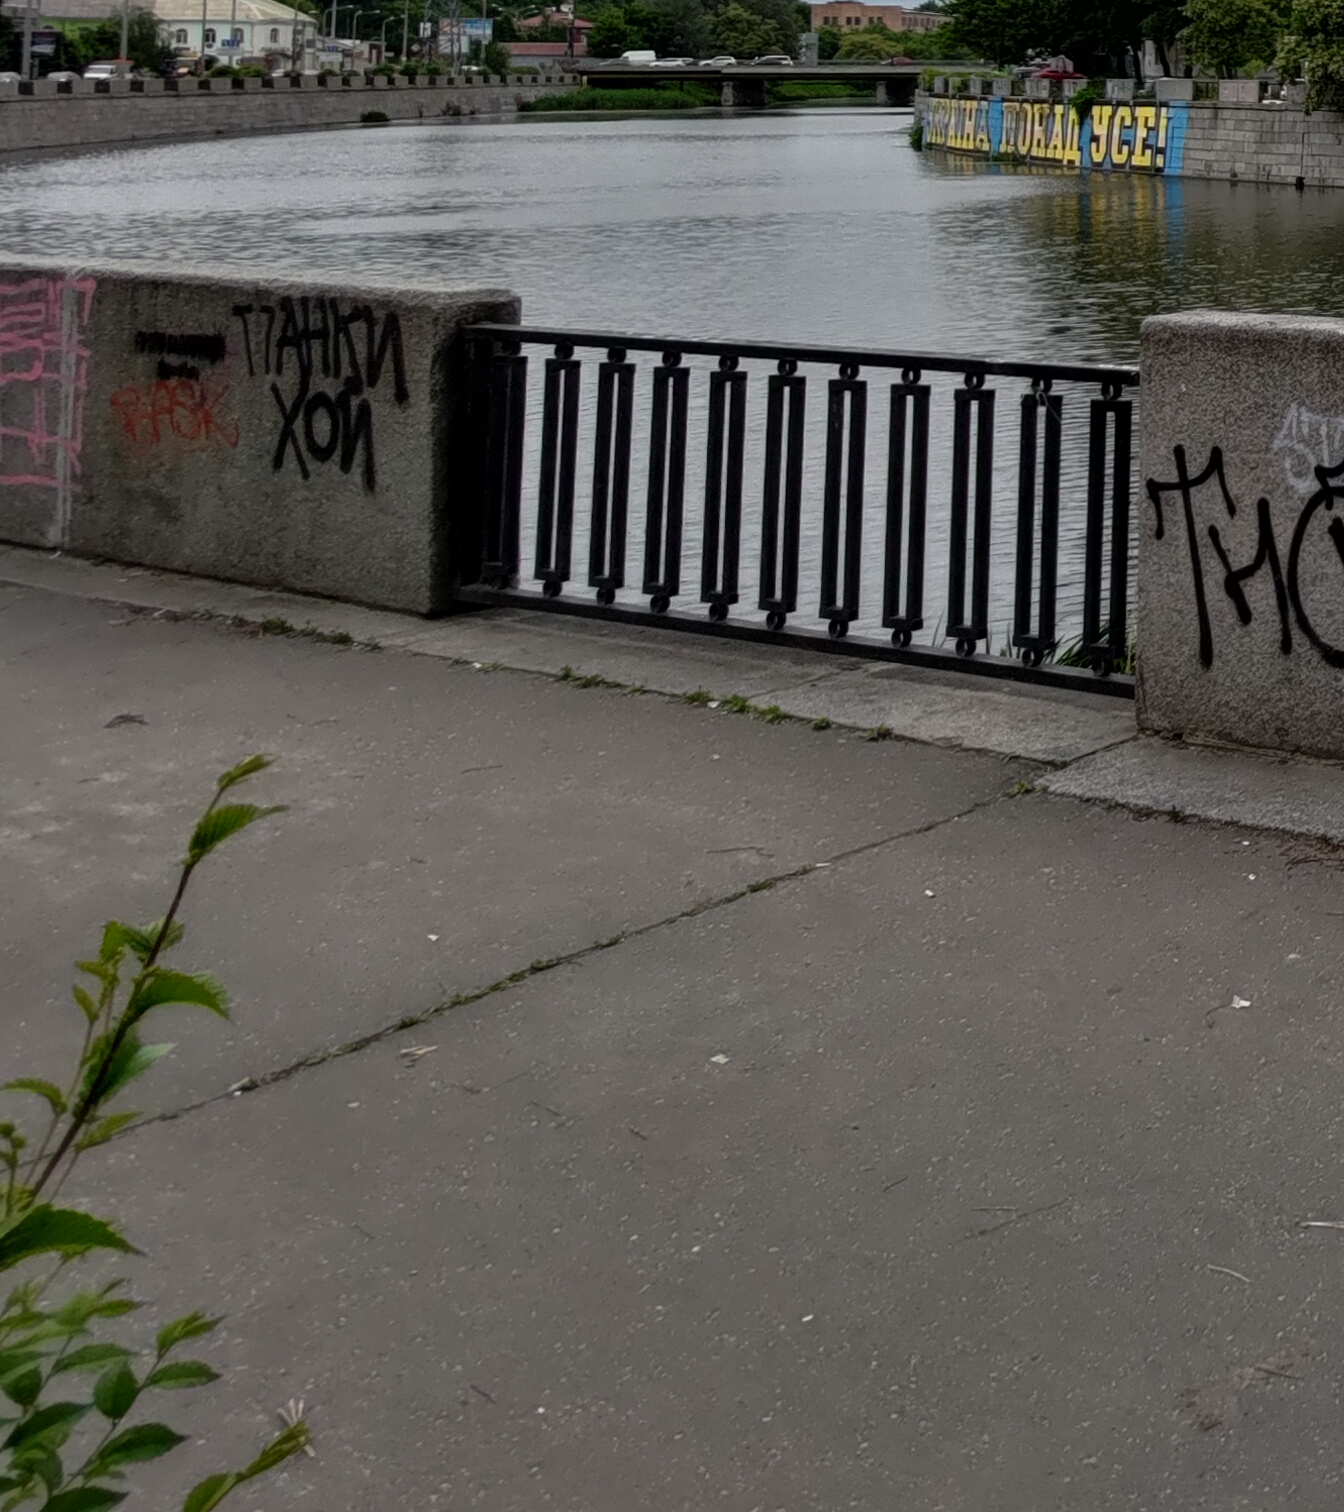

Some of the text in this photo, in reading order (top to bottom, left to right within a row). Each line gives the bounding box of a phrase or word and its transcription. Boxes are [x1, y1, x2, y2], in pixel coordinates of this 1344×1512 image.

[1000, 101, 1082, 167] ПОНАД
[1090, 104, 1169, 168] УСЕ!
[232, 295, 408, 405] ПАНКИ
